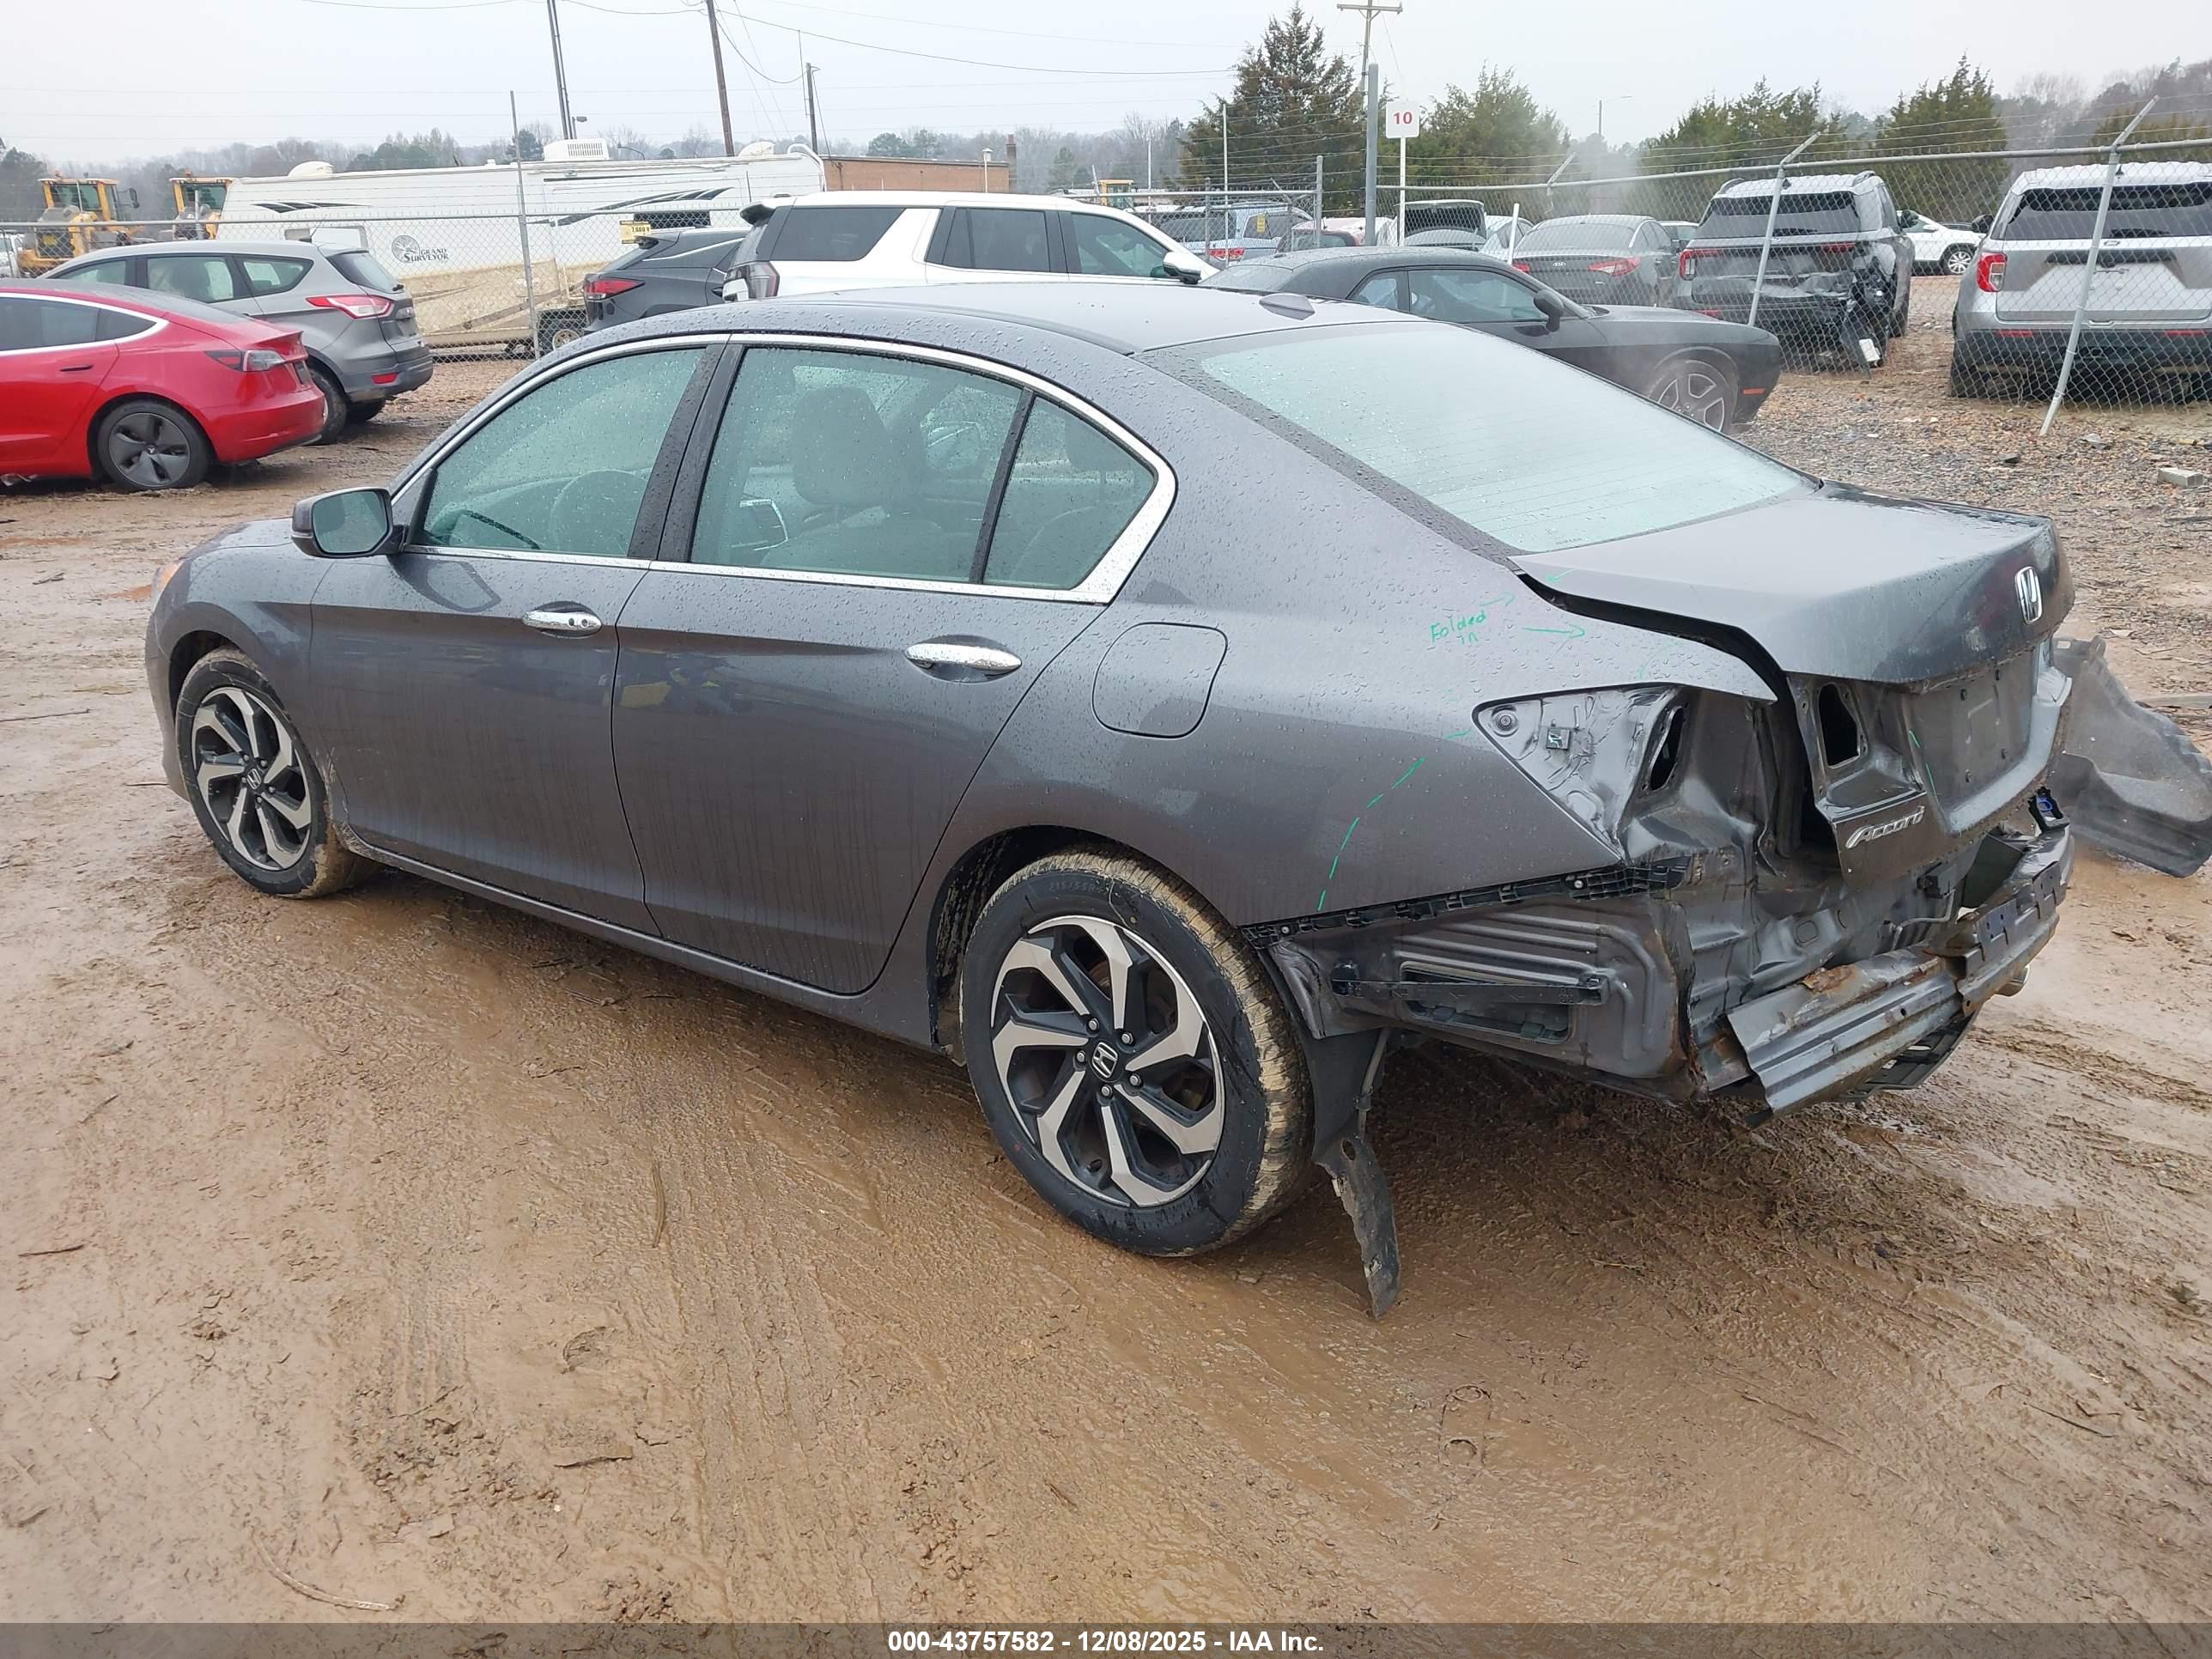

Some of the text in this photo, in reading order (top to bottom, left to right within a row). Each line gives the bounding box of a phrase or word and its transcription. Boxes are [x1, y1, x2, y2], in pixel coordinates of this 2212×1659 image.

[1393, 111, 1413, 125] 10
[404, 252, 449, 263] SURVEYOR
[1431, 611, 1486, 643] Folded
